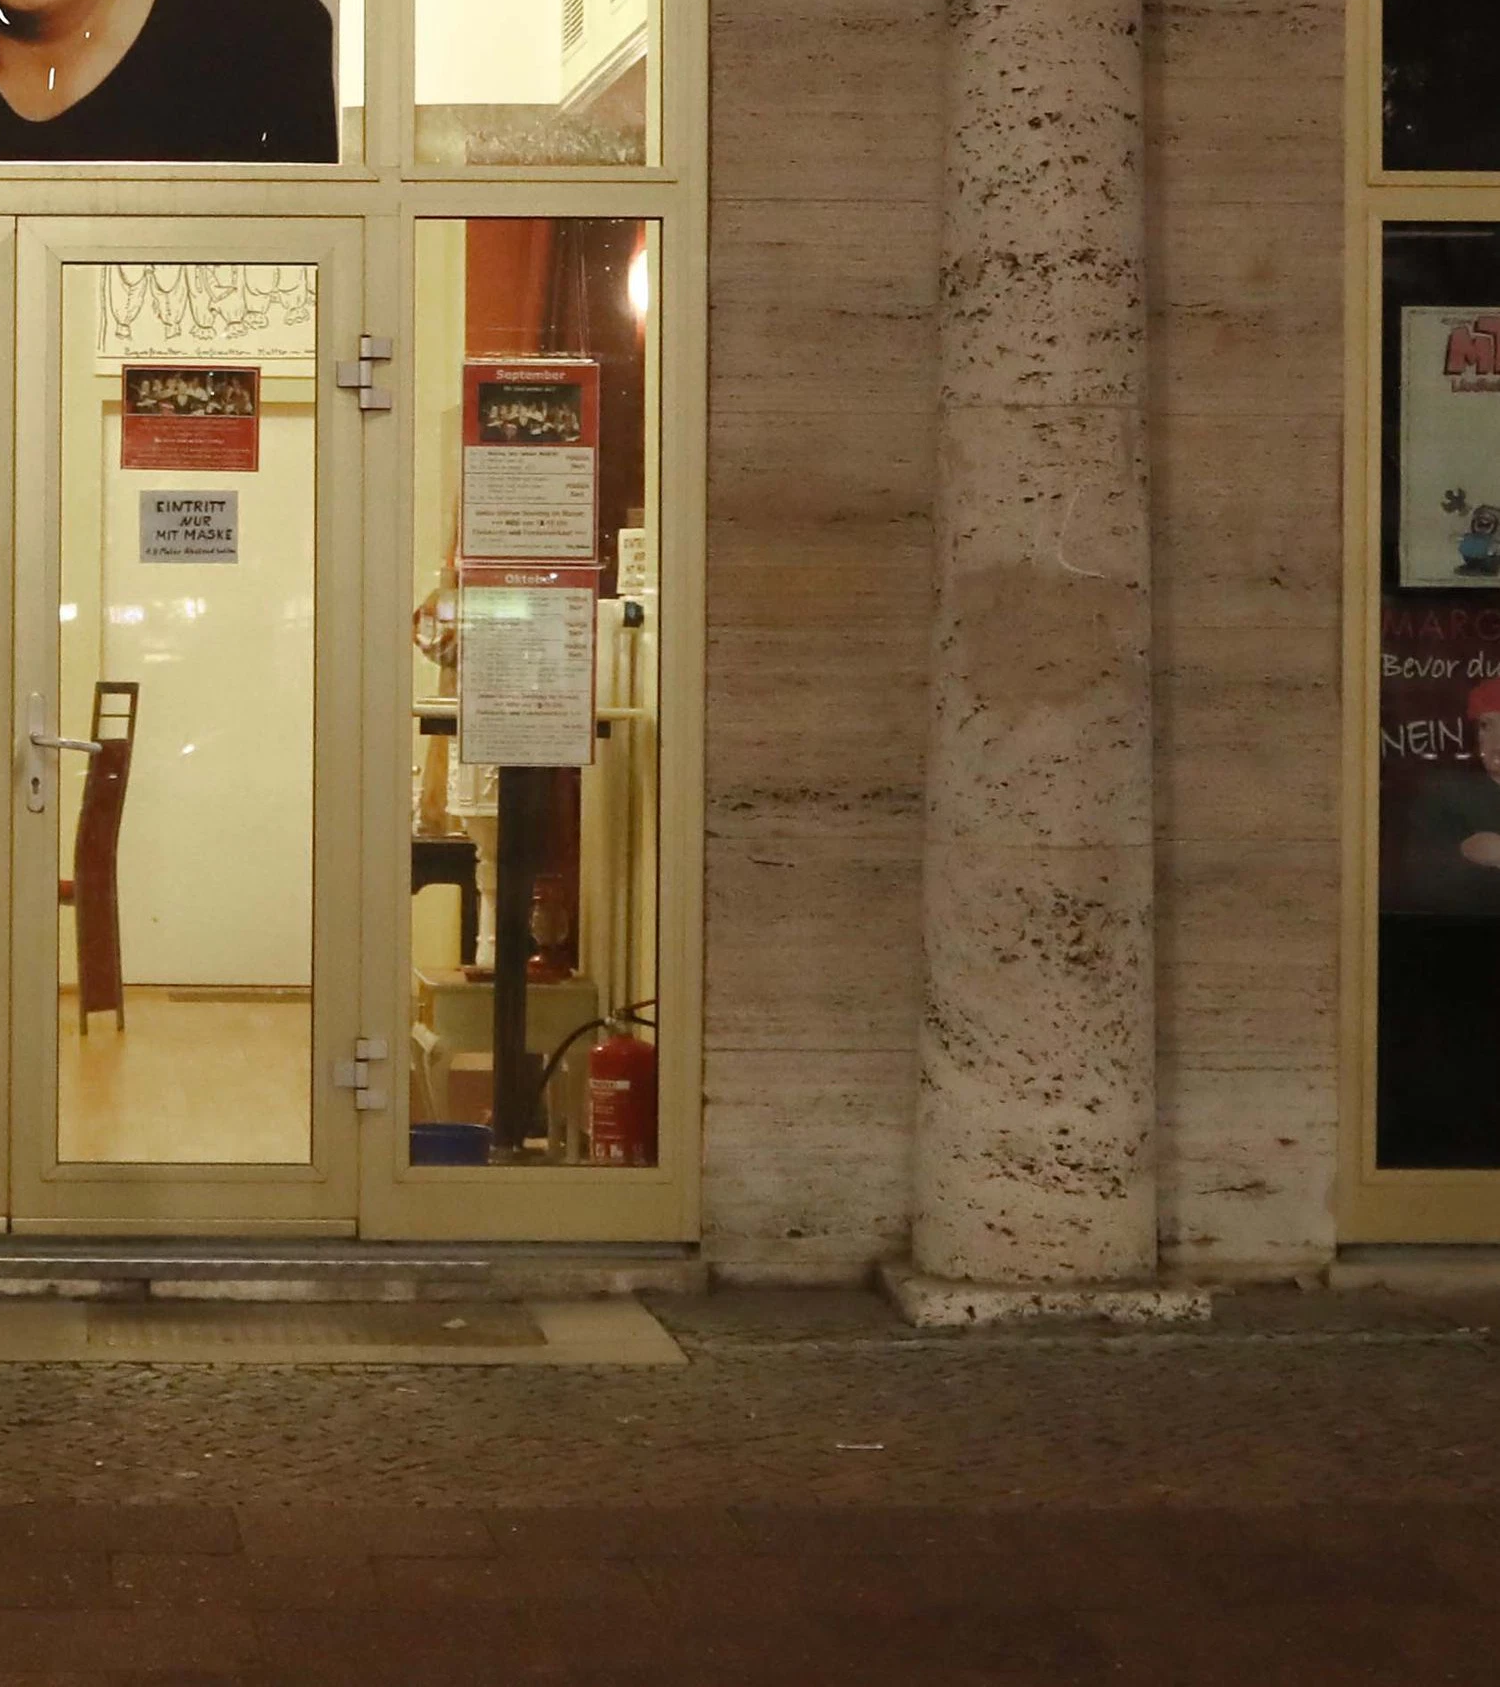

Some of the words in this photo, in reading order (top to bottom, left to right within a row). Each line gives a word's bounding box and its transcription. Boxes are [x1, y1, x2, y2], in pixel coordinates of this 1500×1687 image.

[495, 369, 567, 381] September
[156, 500, 227, 513] EINTRITT
[180, 515, 212, 527] NUR
[156, 530, 179, 541] MIT
[183, 529, 234, 541] MASKE
[504, 572, 556, 585] Oktober
[1381, 653, 1460, 679] Bevor
[1381, 716, 1464, 759] NEIN
